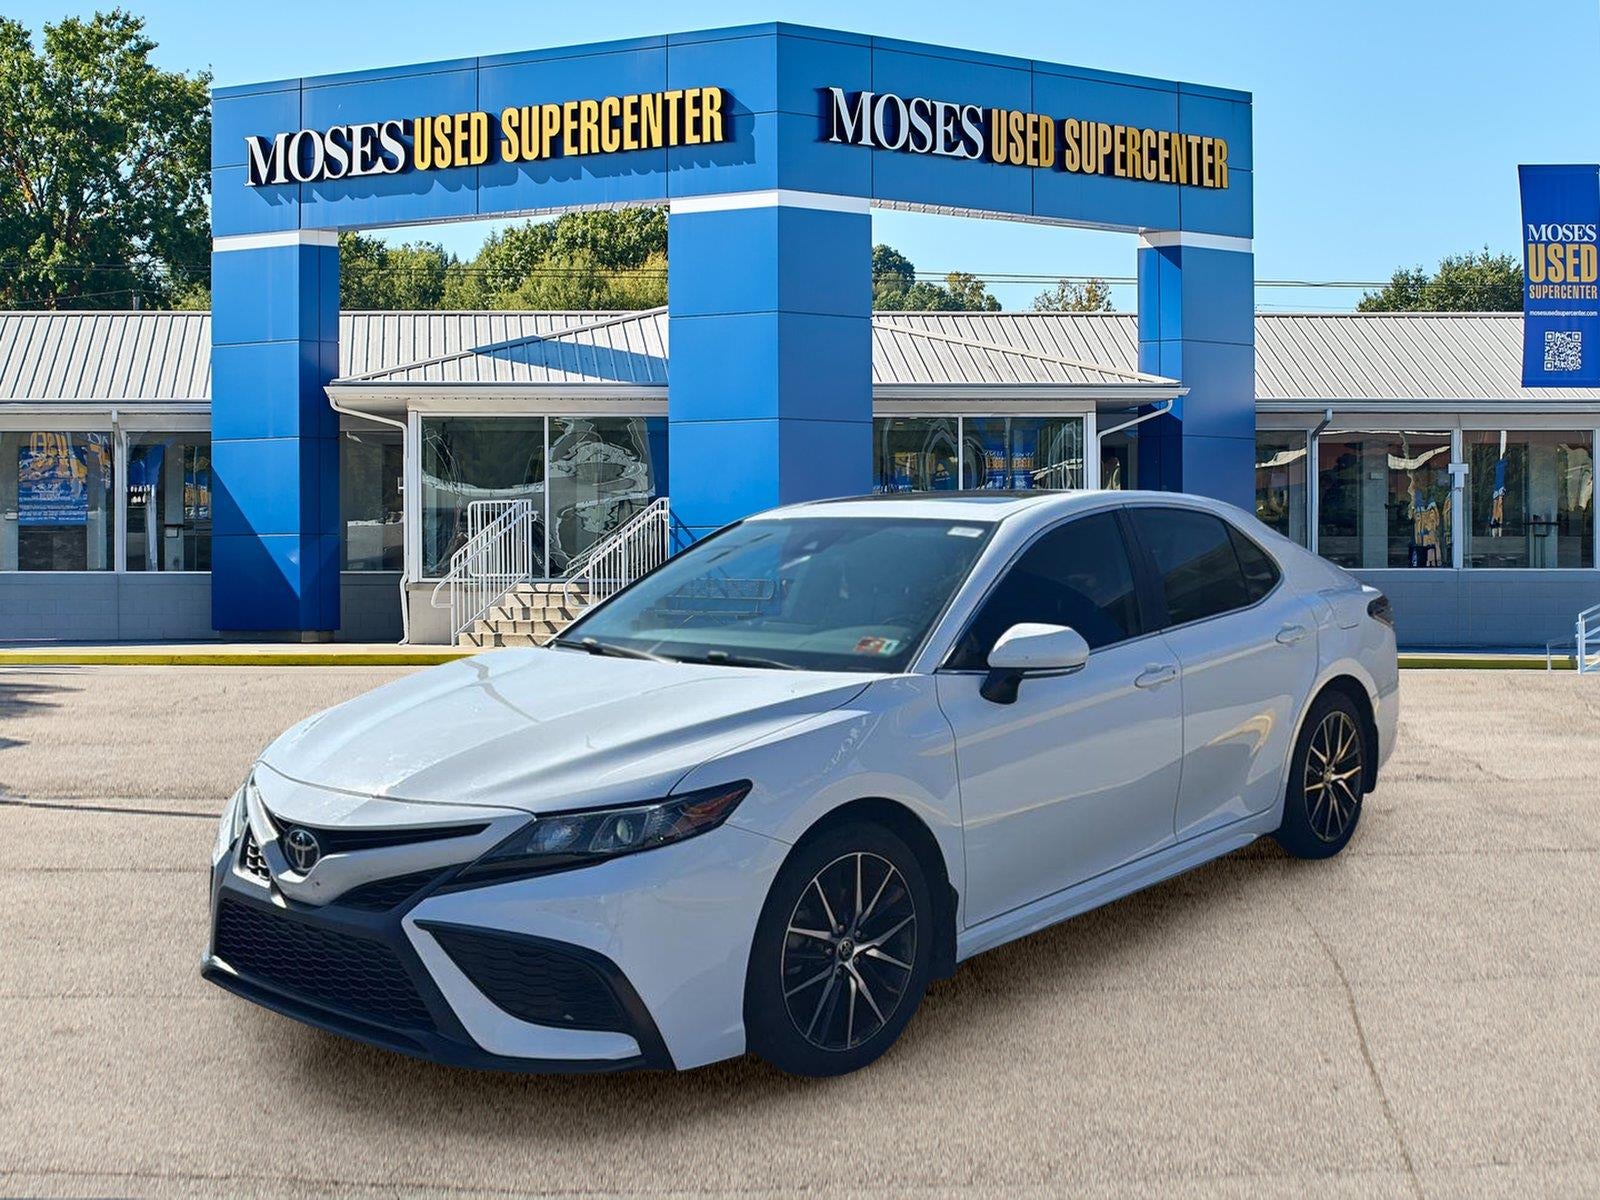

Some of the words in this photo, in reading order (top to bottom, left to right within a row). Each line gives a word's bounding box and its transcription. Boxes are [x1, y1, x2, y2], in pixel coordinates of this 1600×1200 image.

[245, 119, 406, 187] MOSES
[413, 111, 490, 171] USED
[500, 86, 724, 163] SUPERCENTER
[828, 86, 984, 160] MOSES
[991, 108, 1055, 168] USED
[1064, 118, 1229, 189] SUPERCENTER
[1527, 223, 1597, 242] MOSES
[1527, 243, 1598, 283] USED
[1529, 285, 1598, 299] SUPERCENTER
